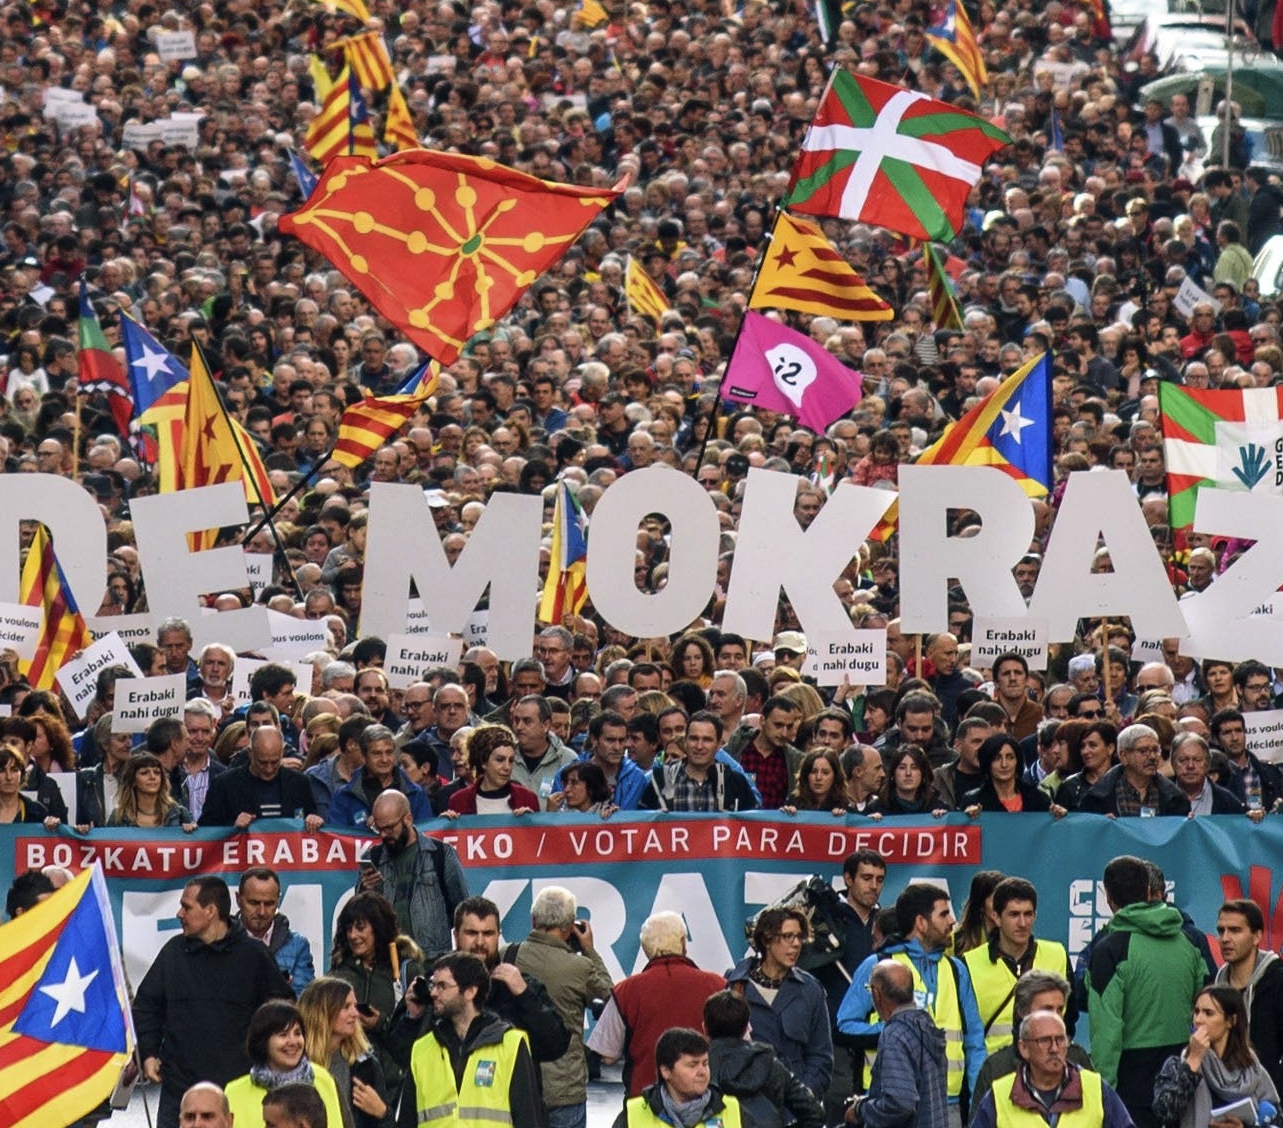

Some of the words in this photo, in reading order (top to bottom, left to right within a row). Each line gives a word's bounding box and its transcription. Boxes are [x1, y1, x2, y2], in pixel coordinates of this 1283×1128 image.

[5, 616, 40, 629] voulons
[289, 631, 325, 643] voulons
[986, 629, 1036, 642] Erabaki
[399, 648, 449, 664] Erabaki
[829, 643, 873, 655] Erabaki
[71, 649, 116, 685] Erabaki
[390, 663, 419, 677] nahi
[823, 659, 847, 671] nahi
[849, 658, 879, 672] dugu
[128, 688, 175, 703] Erabaki
[120, 707, 150, 719] nahi
[152, 705, 180, 720] dugu
[1246, 738, 1283, 750] décider
[27, 843, 203, 870] BOZKATU
[569, 826, 692, 856] VOTAR
[713, 825, 804, 854] PARA
[828, 830, 969, 858] DECIDIR
